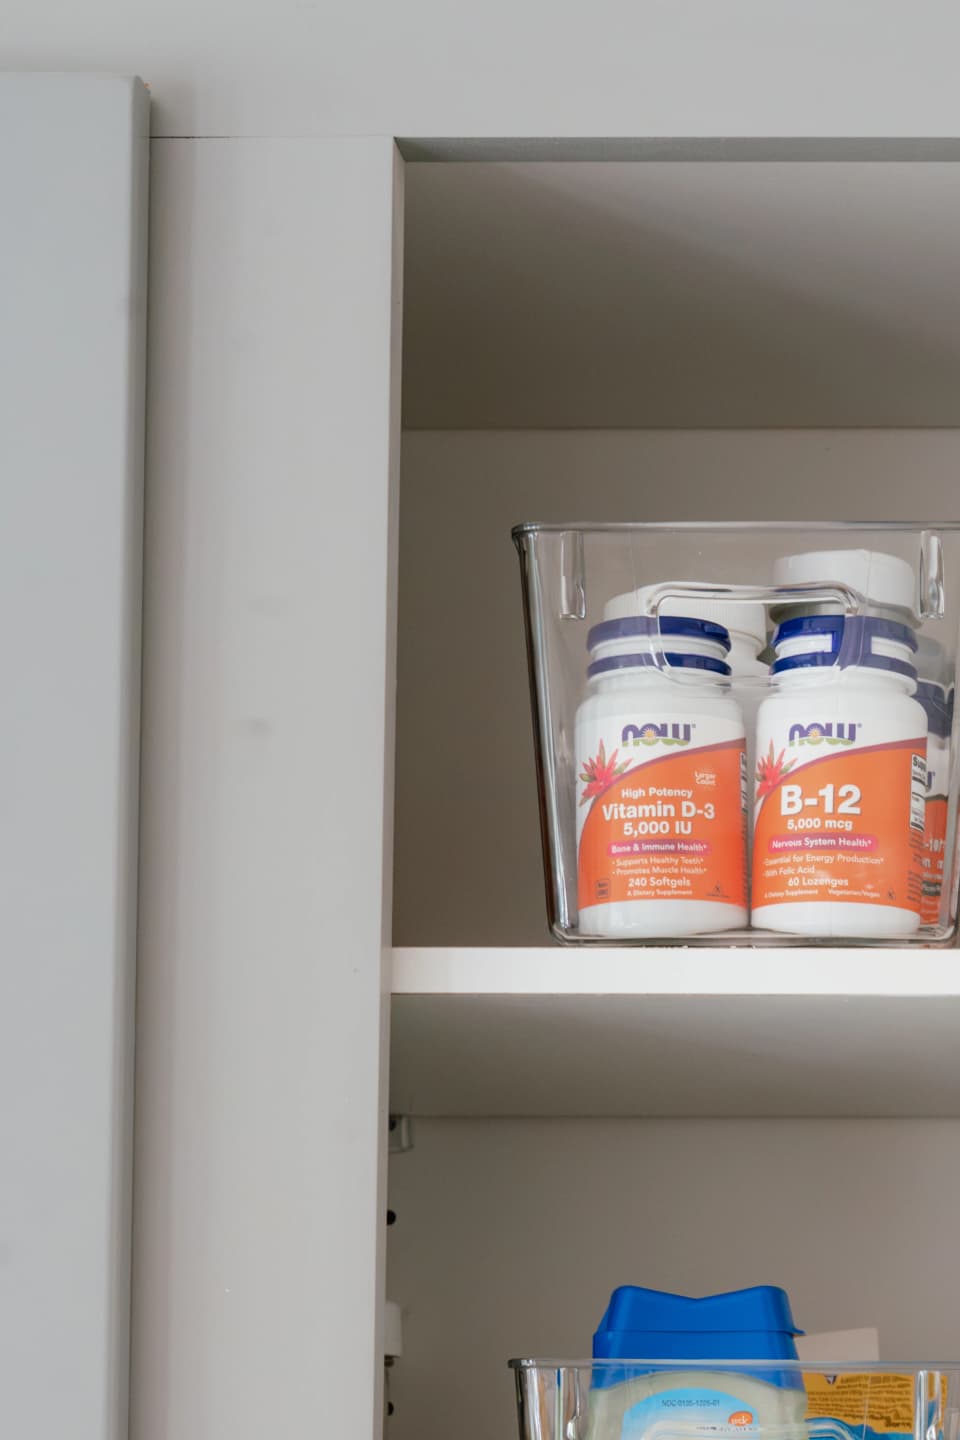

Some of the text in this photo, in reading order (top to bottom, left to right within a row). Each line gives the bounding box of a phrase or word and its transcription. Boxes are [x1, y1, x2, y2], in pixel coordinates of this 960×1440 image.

[622, 787, 692, 798] High Potency
[781, 784, 861, 816] B-12
[602, 801, 716, 820] Vitamin D-3
[623, 821, 692, 836] 5,000 IU
[787, 818, 853, 832] 5,000 mcg
[611, 844, 631, 854] Bone
[642, 843, 674, 851] Immune
[772, 838, 836, 848] Nervous System
[616, 856, 678, 866] Supports Healthy
[806, 854, 834, 864] Energy
[652, 866, 678, 874] Muscle
[797, 866, 815, 874] Acid
[628, 876, 691, 888] 240 Softgels
[788, 877, 848, 888] 60 Lozenges
